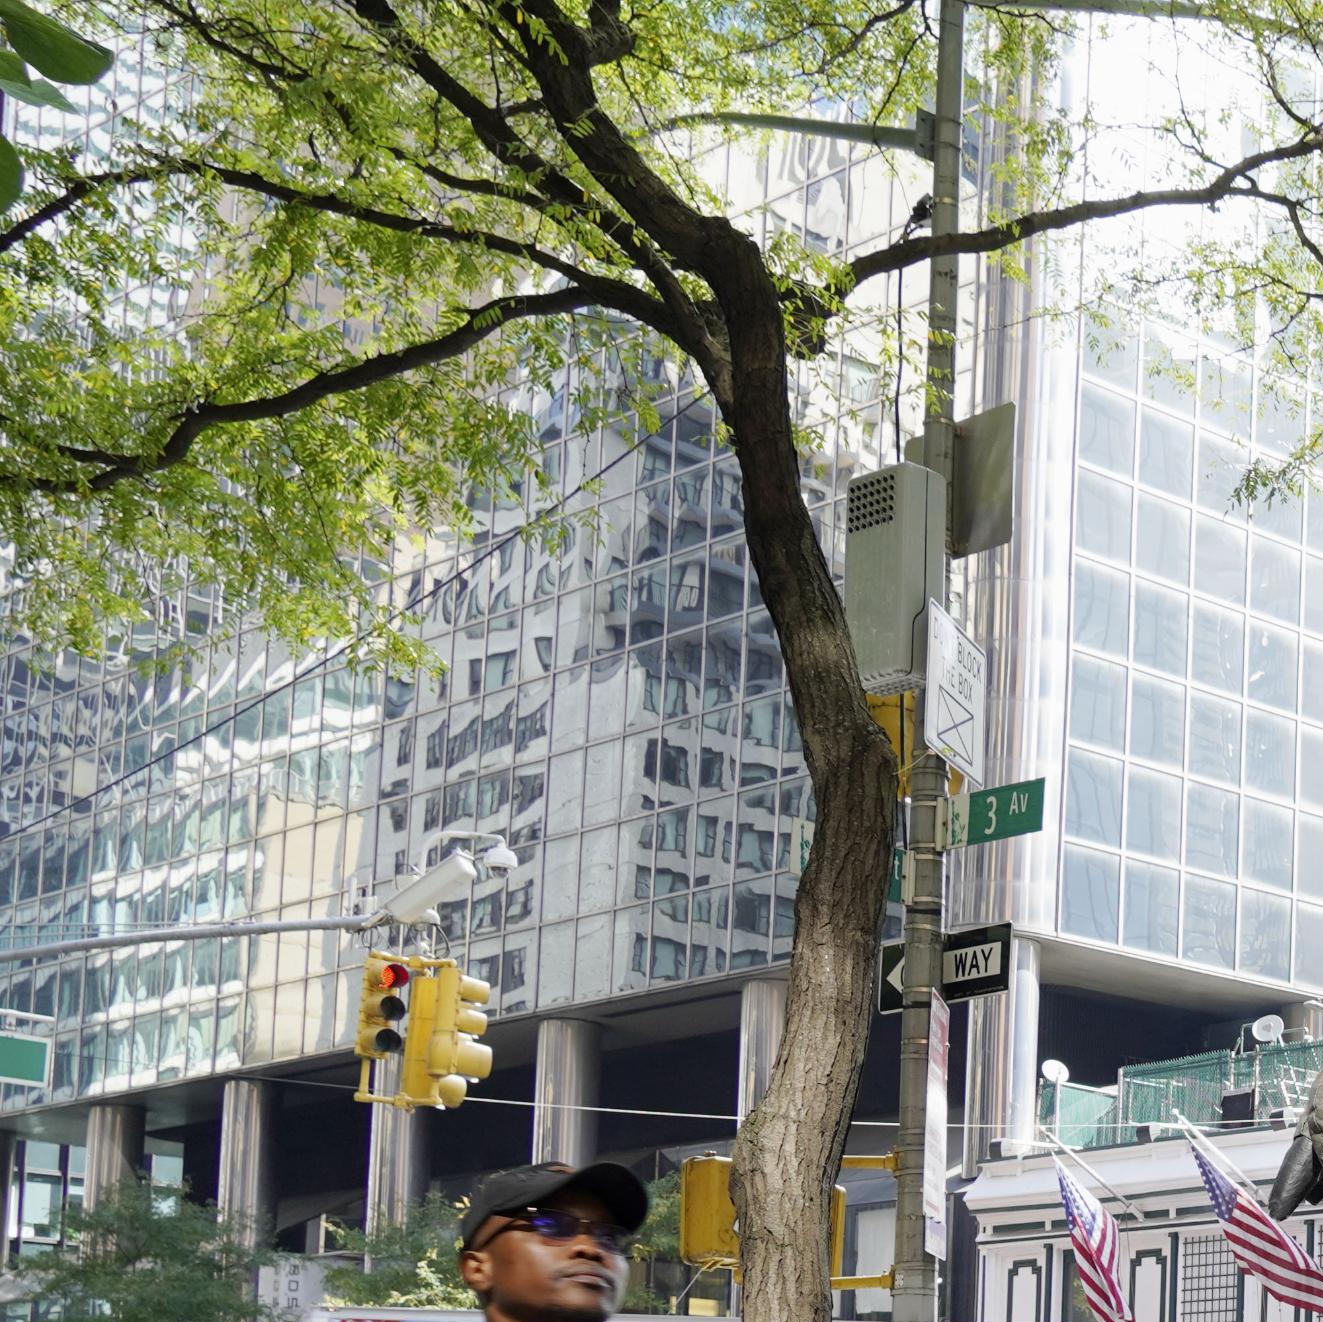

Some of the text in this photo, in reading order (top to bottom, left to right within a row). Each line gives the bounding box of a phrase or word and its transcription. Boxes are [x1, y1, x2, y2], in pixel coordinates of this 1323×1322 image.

[957, 641, 982, 683] BLOCK
[958, 673, 973, 704] BOX
[984, 796, 997, 835] 3
[954, 947, 993, 978] WAY
